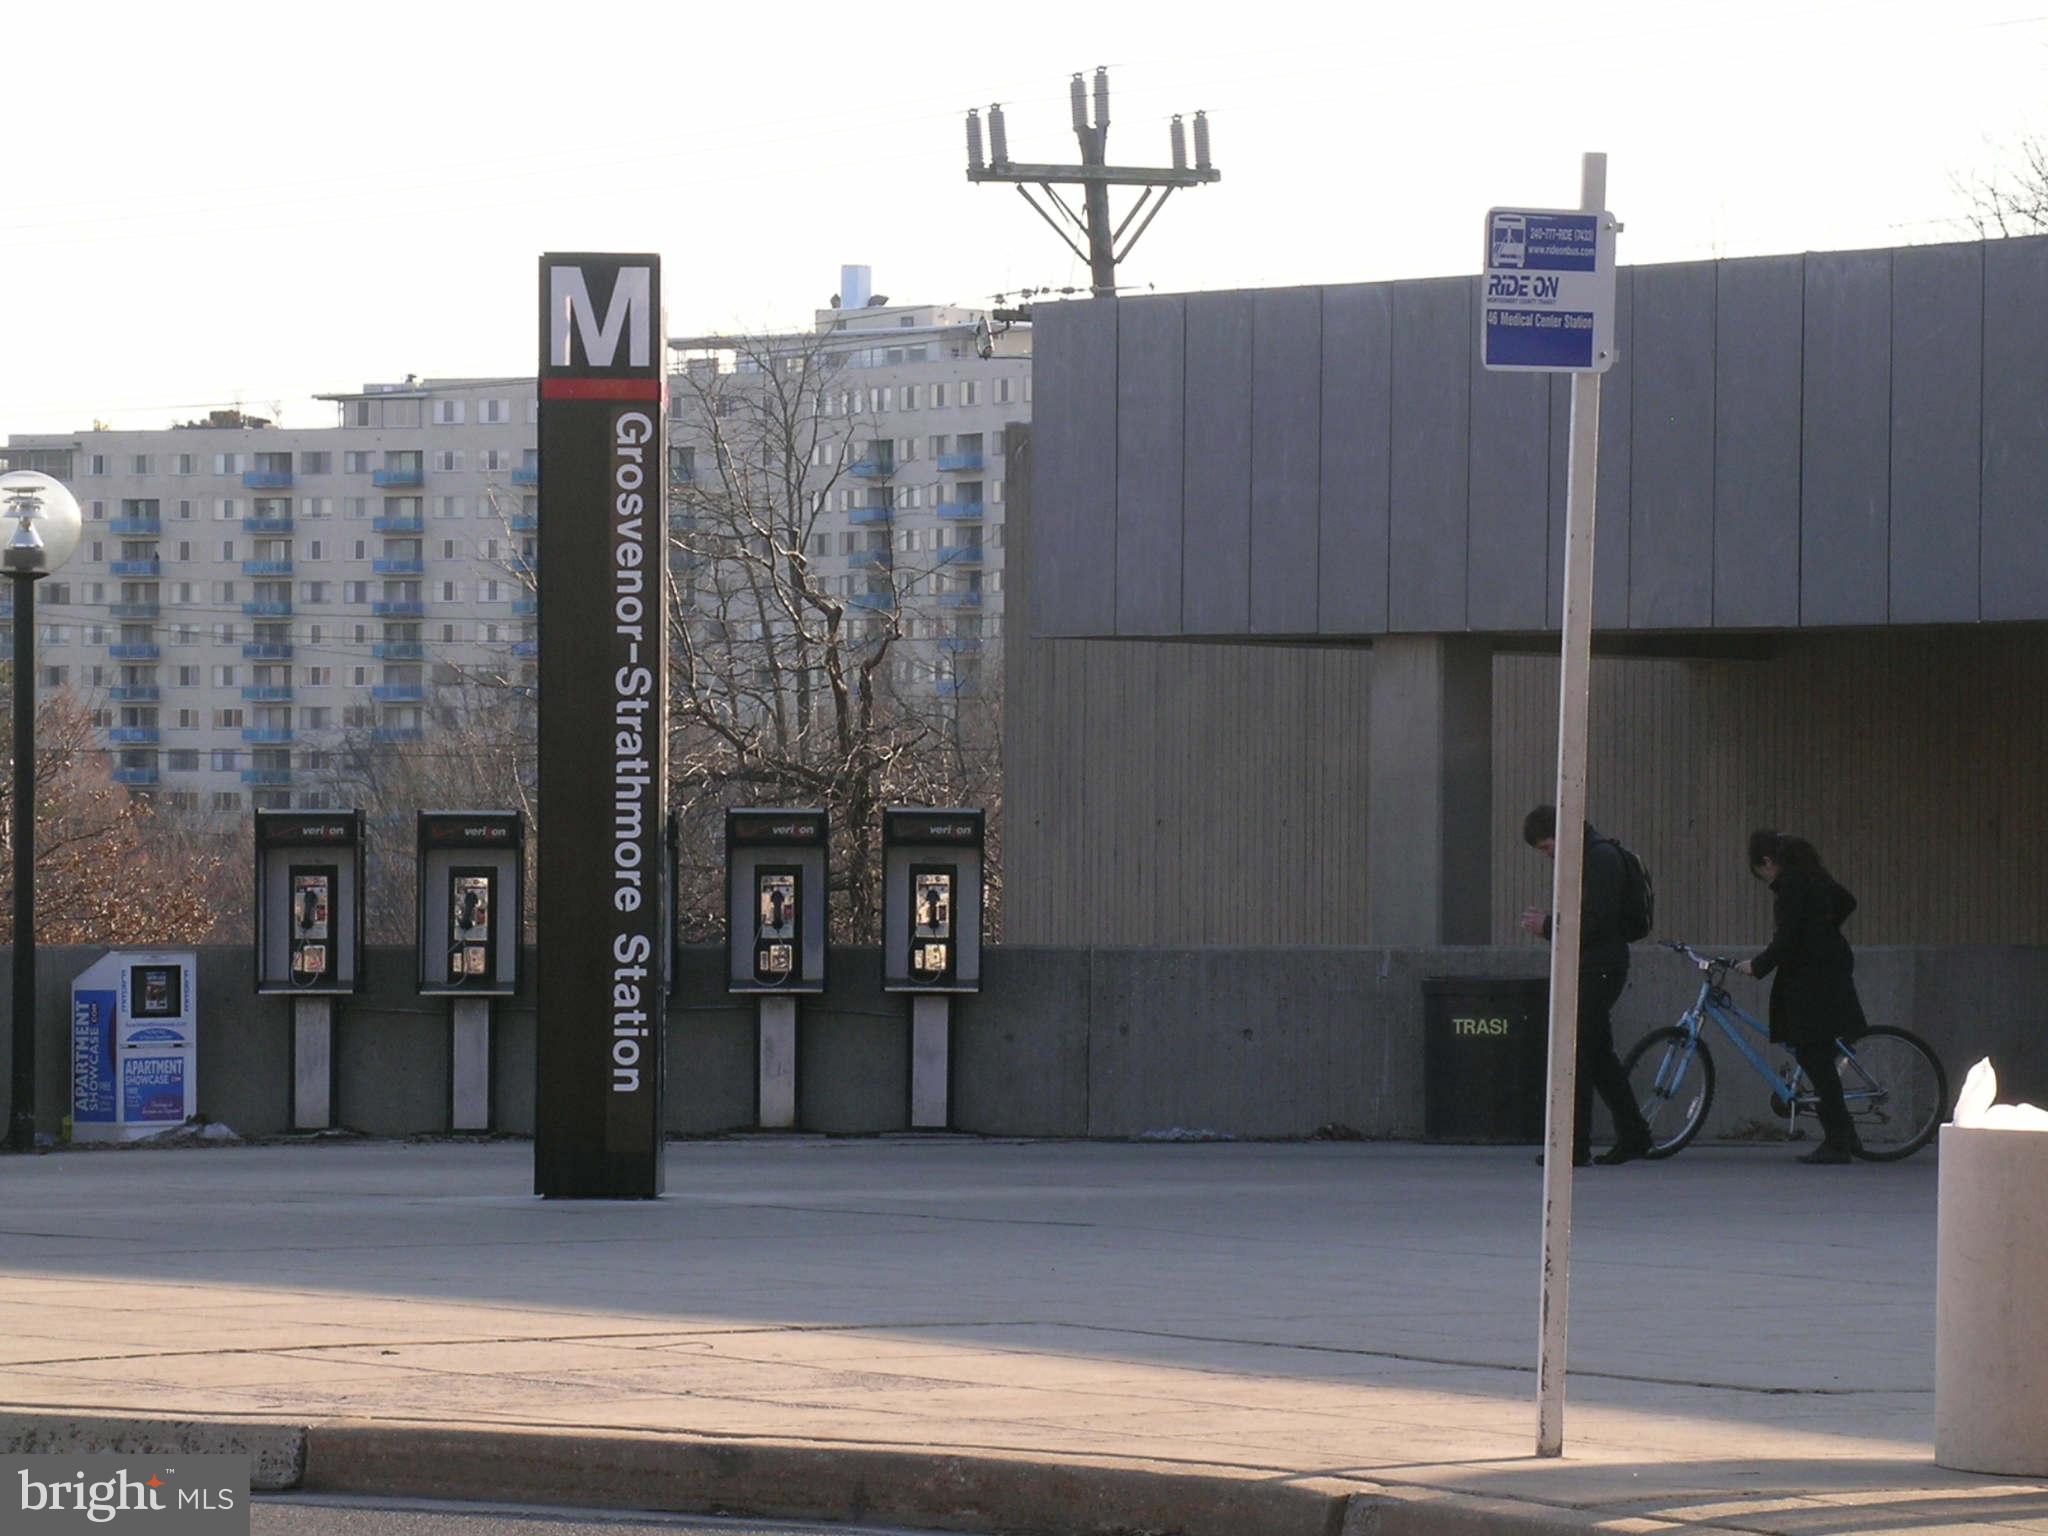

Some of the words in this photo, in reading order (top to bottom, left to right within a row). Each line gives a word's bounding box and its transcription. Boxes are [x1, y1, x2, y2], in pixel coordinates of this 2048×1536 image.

[1533, 277, 1559, 298] ON
[550, 265, 650, 368] M
[1487, 312, 1498, 325] 46
[1500, 312, 1533, 326] Medical
[1535, 314, 1563, 328] Center
[1564, 315, 1593, 329] Station
[613, 411, 653, 912] Grosvenor-Strathmore
[302, 824, 344, 837] verizon
[464, 825, 507, 838] verizon
[612, 934, 651, 1093] Station
[75, 1000, 90, 1111] APARTMENT
[88, 1027, 100, 1111] SHOWCASE
[126, 1059, 184, 1074] APARTMENT
[125, 1074, 170, 1085] SHOWCASE
